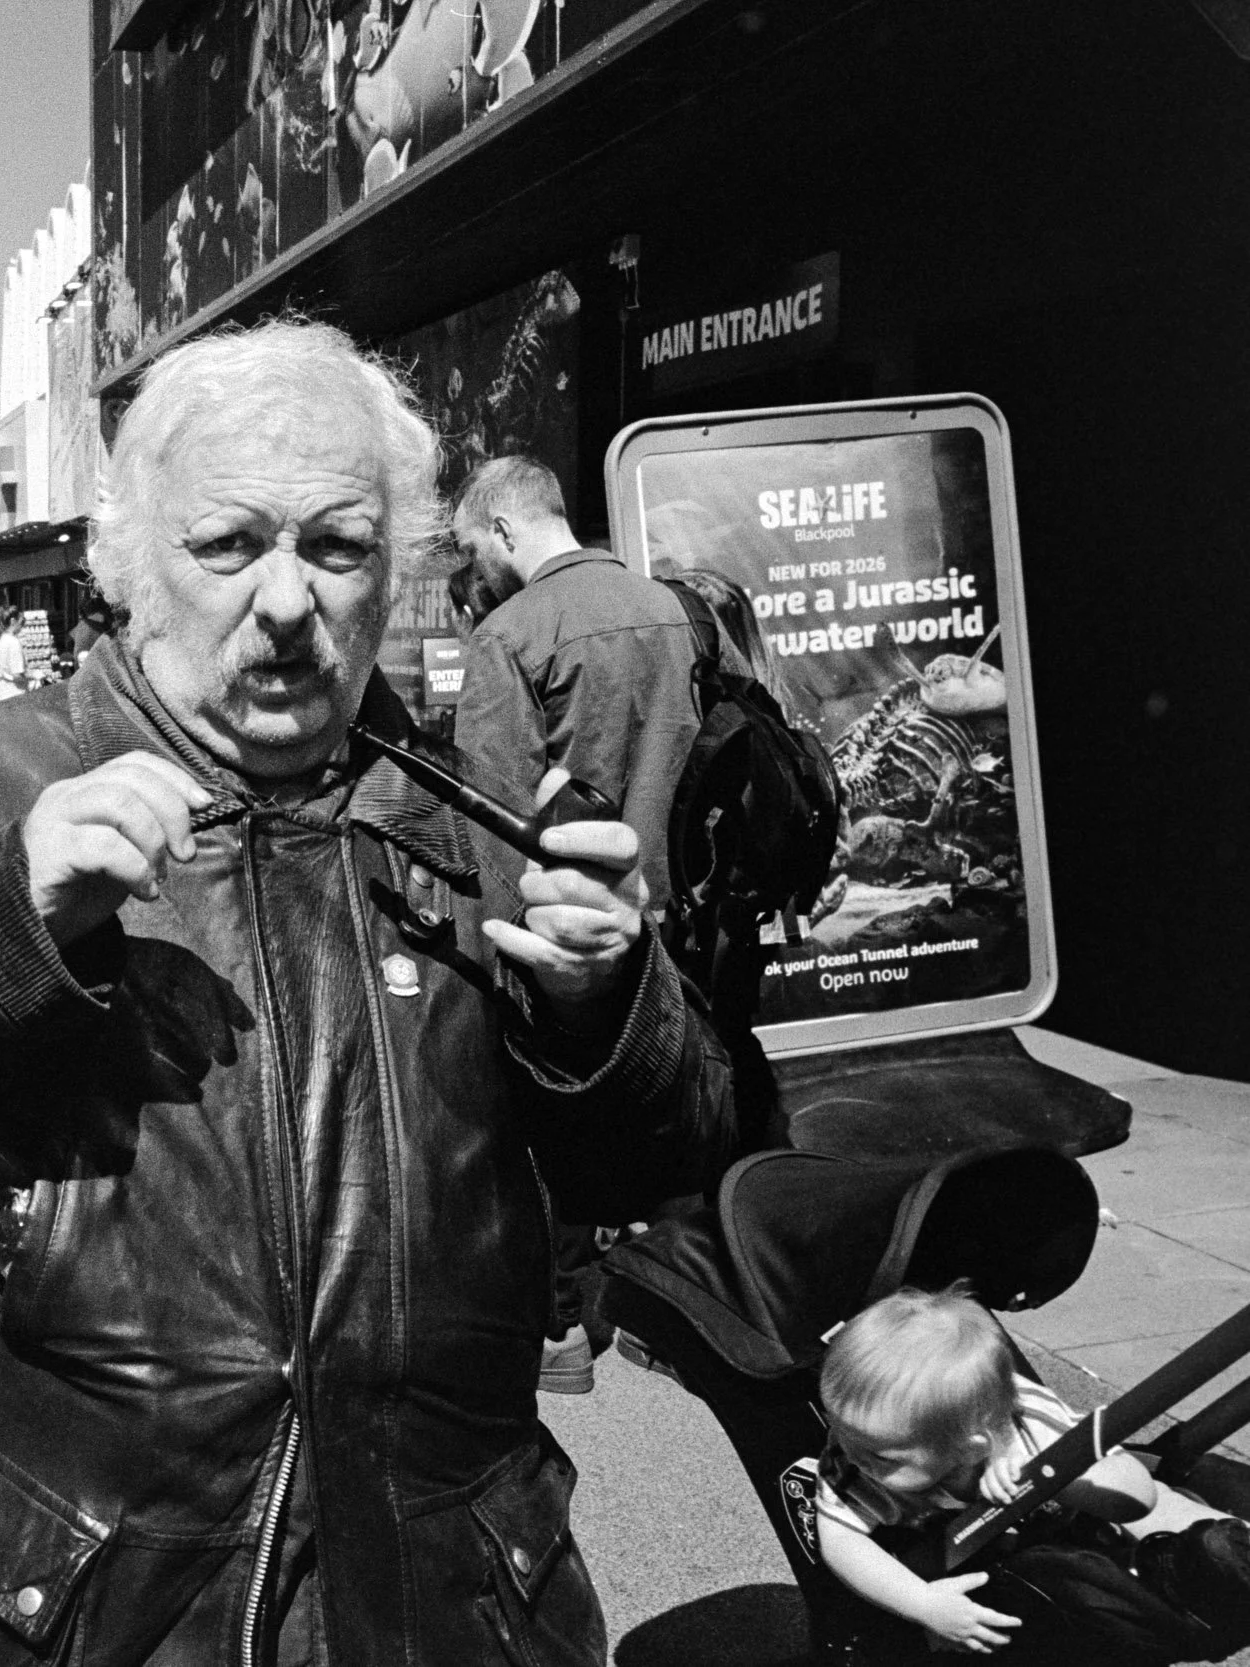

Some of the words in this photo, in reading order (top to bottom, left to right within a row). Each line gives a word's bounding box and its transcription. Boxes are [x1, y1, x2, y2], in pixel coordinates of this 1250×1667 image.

[641, 320, 694, 370] MAIN
[701, 283, 823, 352] ENTRANCE
[758, 487, 821, 529] SEA
[795, 523, 855, 543] Blackpool
[768, 563, 806, 582] NEW
[809, 561, 842, 578] FOR
[845, 556, 886, 574] 2026
[745, 588, 807, 619] ore
[815, 587, 835, 613] a
[843, 567, 977, 611] Jurassic
[888, 605, 984, 645] world
[432, 680, 462, 692] HER
[784, 957, 816, 977] your
[817, 950, 859, 969] Ocean
[860, 943, 909, 963] Tunnel
[910, 937, 979, 957] adventure
[820, 969, 864, 992] Open
[869, 966, 909, 984] now
